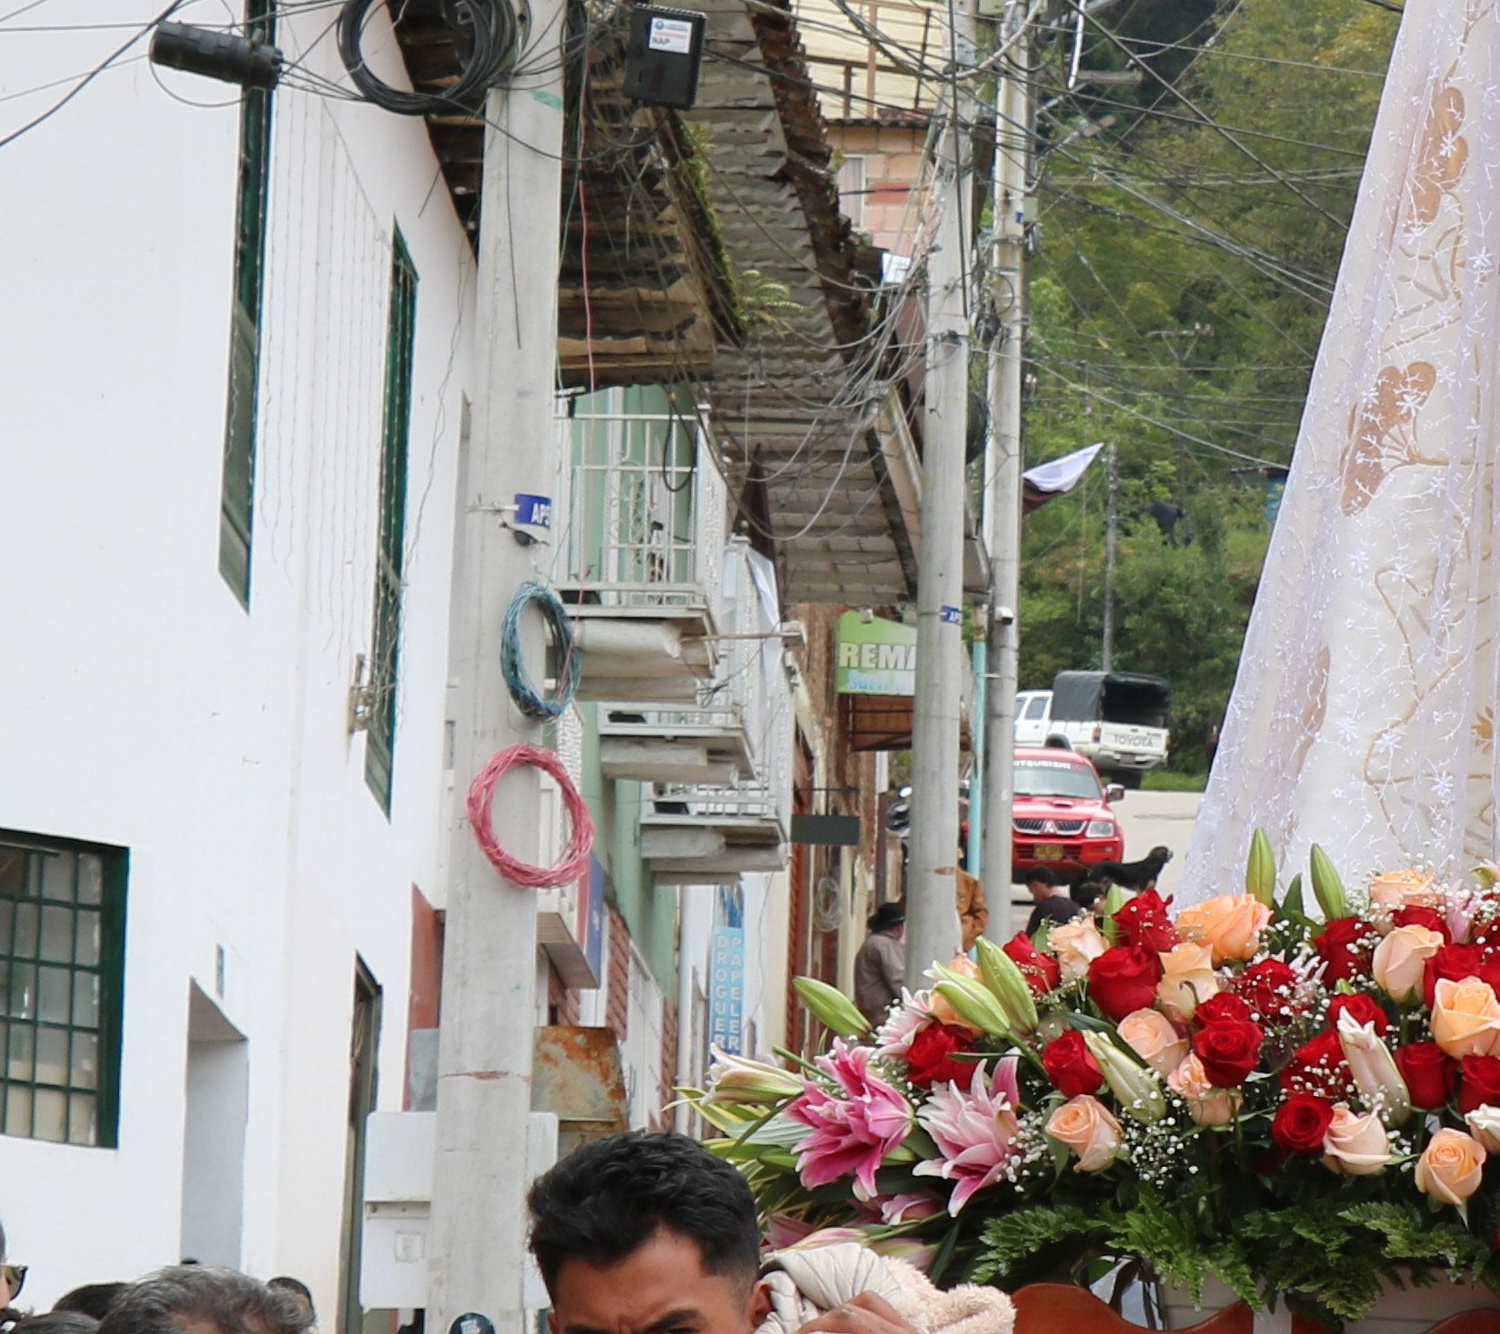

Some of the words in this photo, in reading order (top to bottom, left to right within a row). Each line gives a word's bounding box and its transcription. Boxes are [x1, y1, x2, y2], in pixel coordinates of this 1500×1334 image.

[1113, 733, 1153, 748] TOYOTA
[714, 935, 728, 1050] DROGUER
[728, 936, 742, 1055] PAPELER
